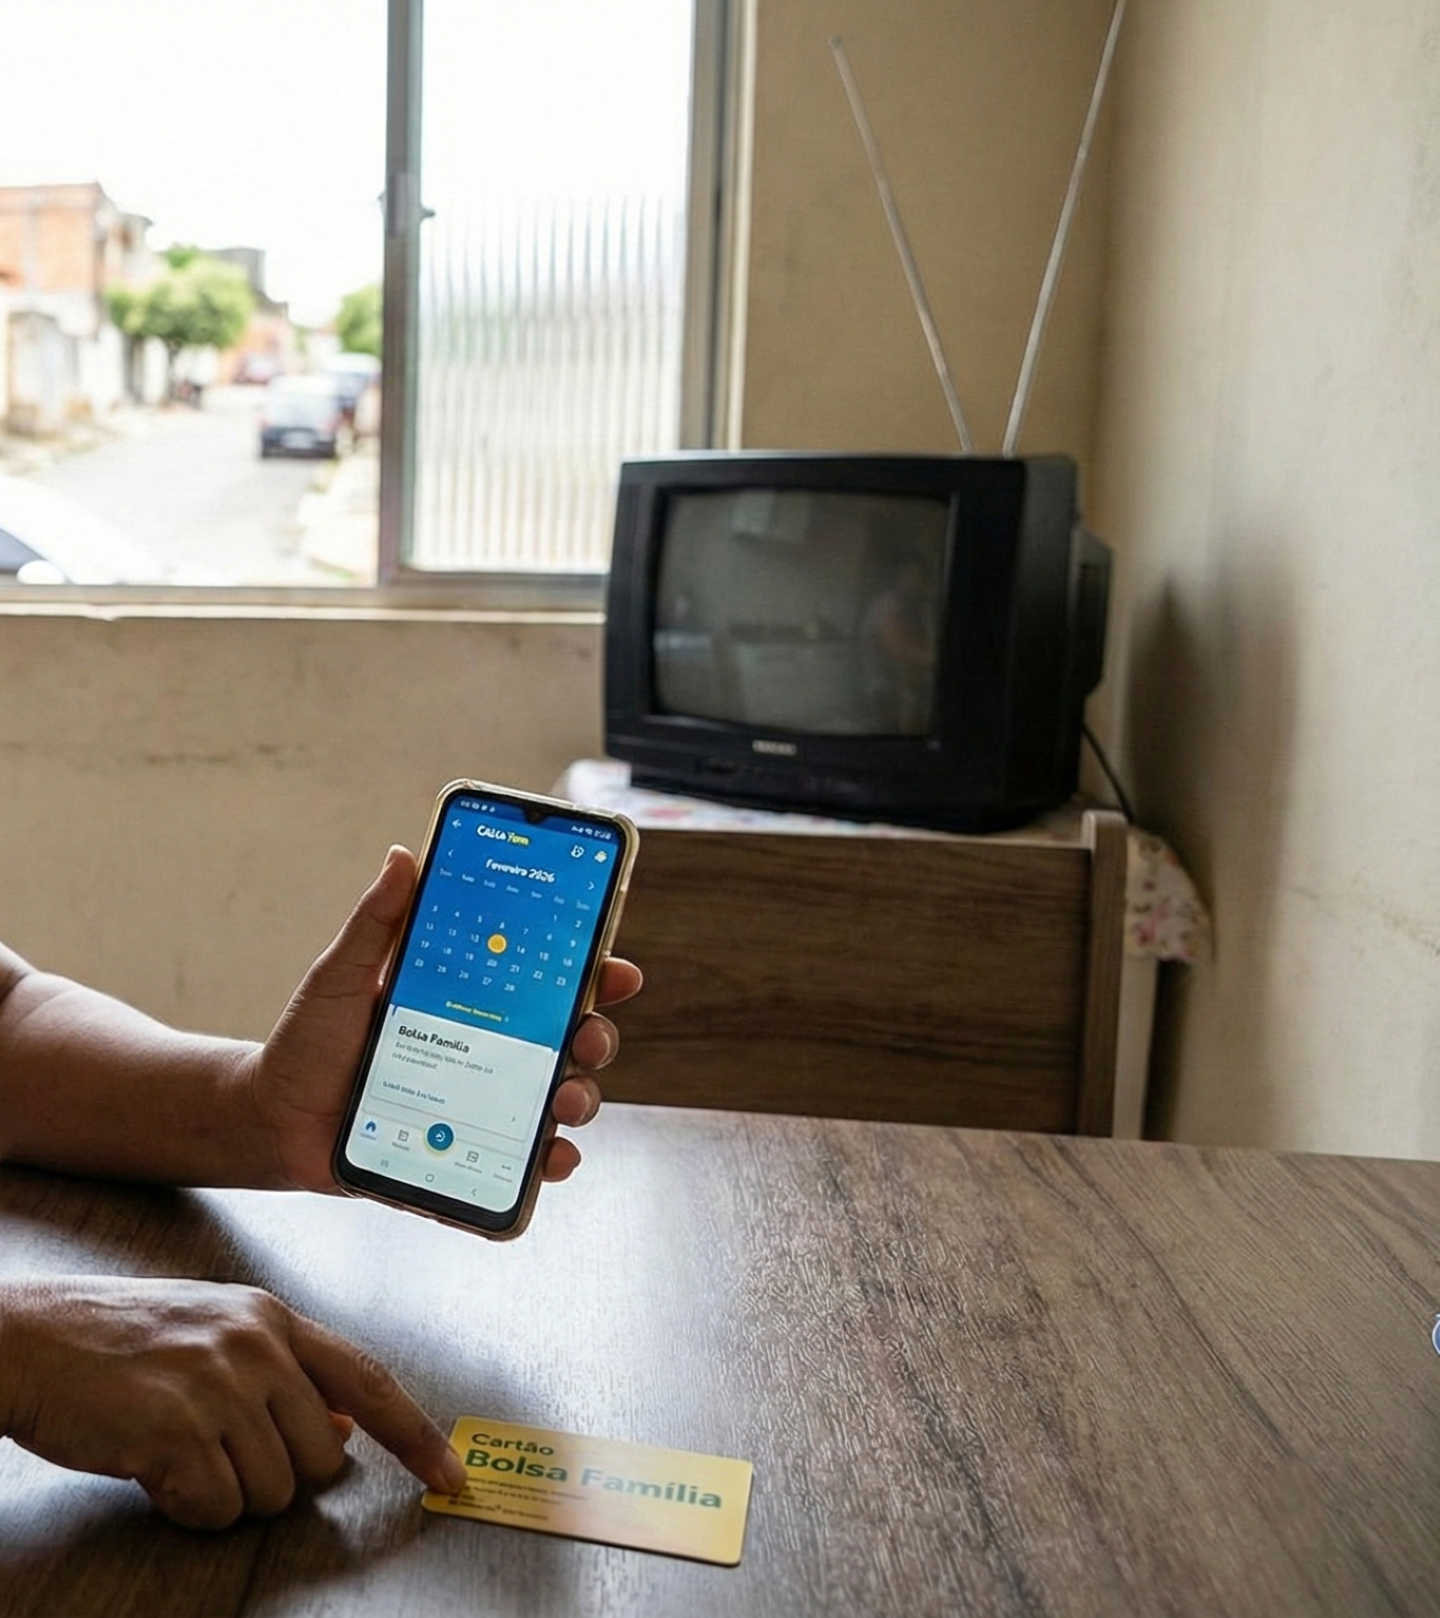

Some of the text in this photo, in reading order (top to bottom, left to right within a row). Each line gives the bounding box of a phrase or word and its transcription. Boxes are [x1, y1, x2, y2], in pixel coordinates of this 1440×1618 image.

[471, 1433, 555, 1456] Cartão
[464, 1449, 568, 1482] Bolsa
[581, 1467, 723, 1509] Família
